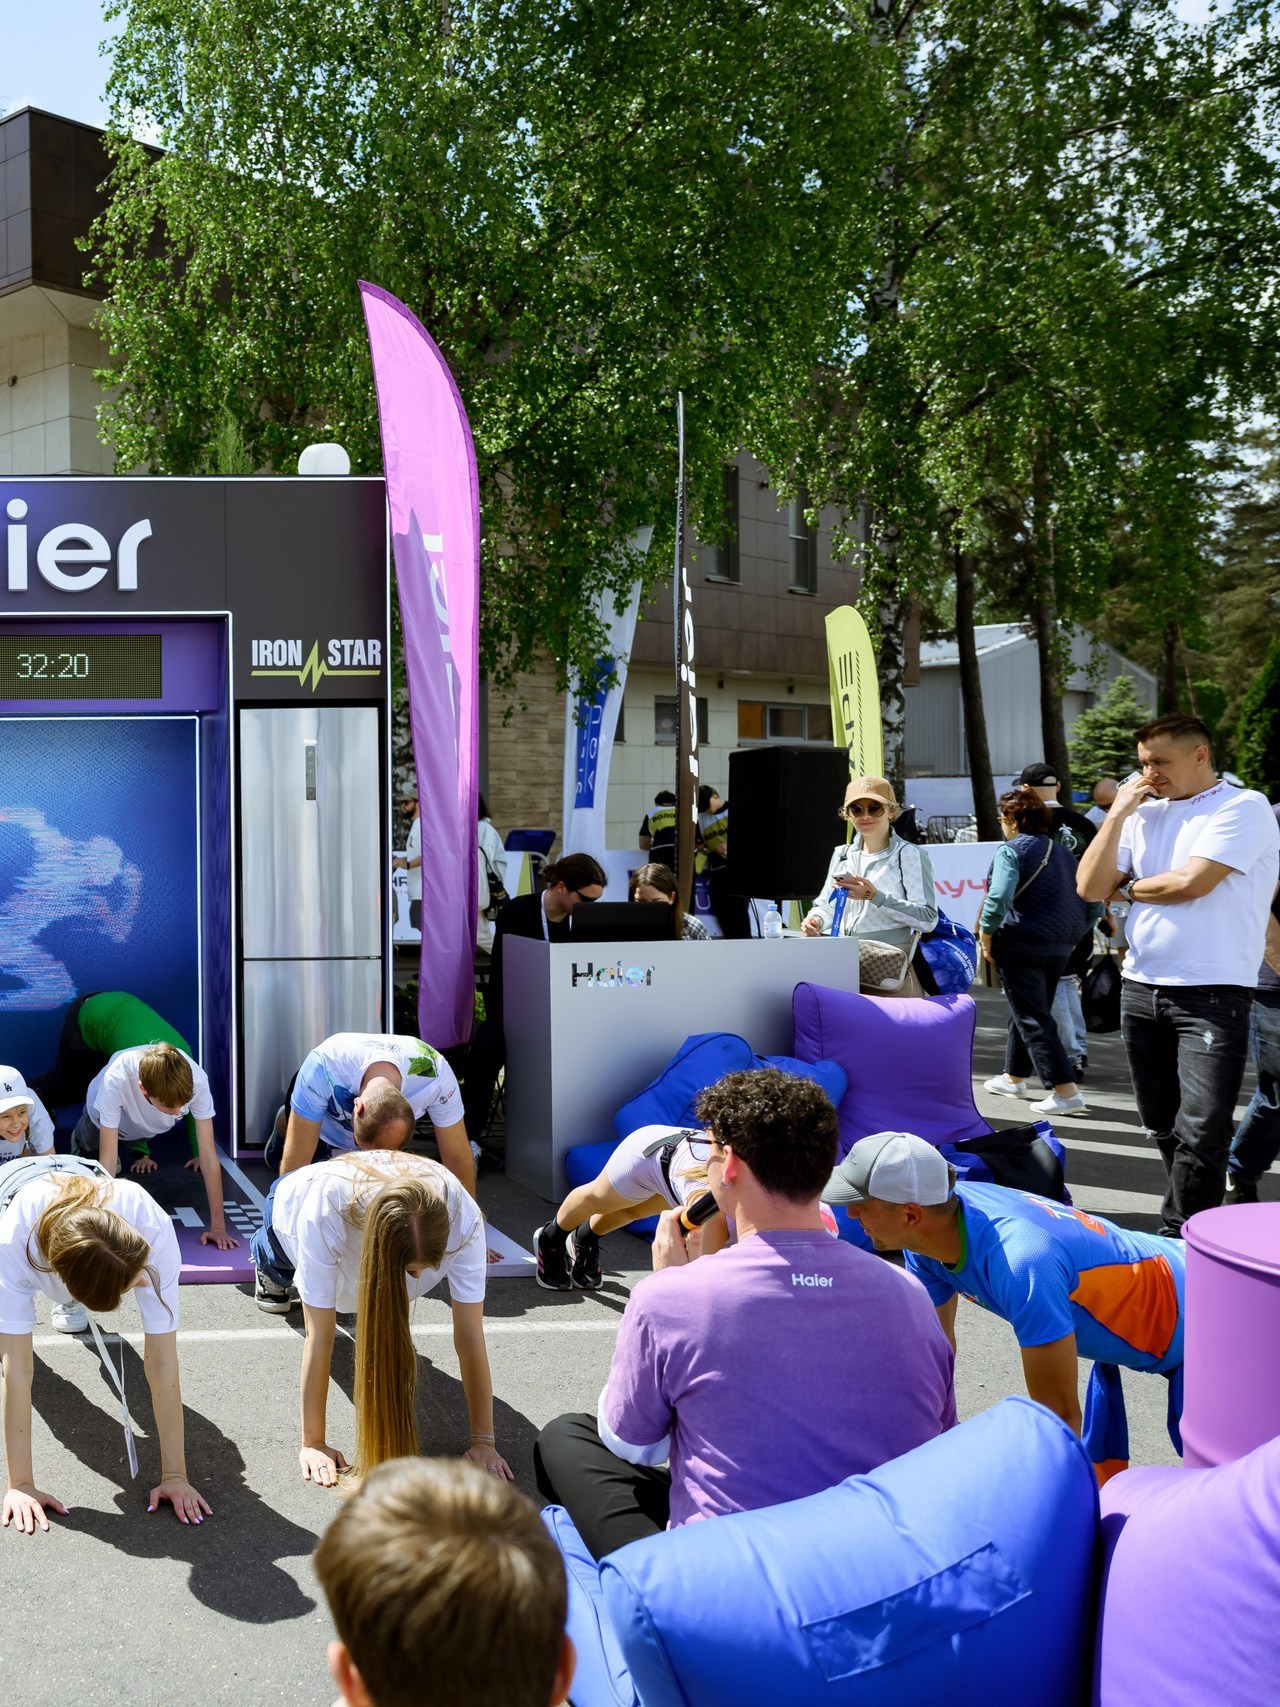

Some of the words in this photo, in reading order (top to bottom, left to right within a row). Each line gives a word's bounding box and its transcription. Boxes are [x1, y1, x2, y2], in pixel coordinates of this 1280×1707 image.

[16, 653, 89, 678] 32:20
[251, 639, 302, 667] IRON
[327, 639, 382, 666] STAR
[571, 960, 656, 987] Haier
[791, 1273, 833, 1287] Haier
